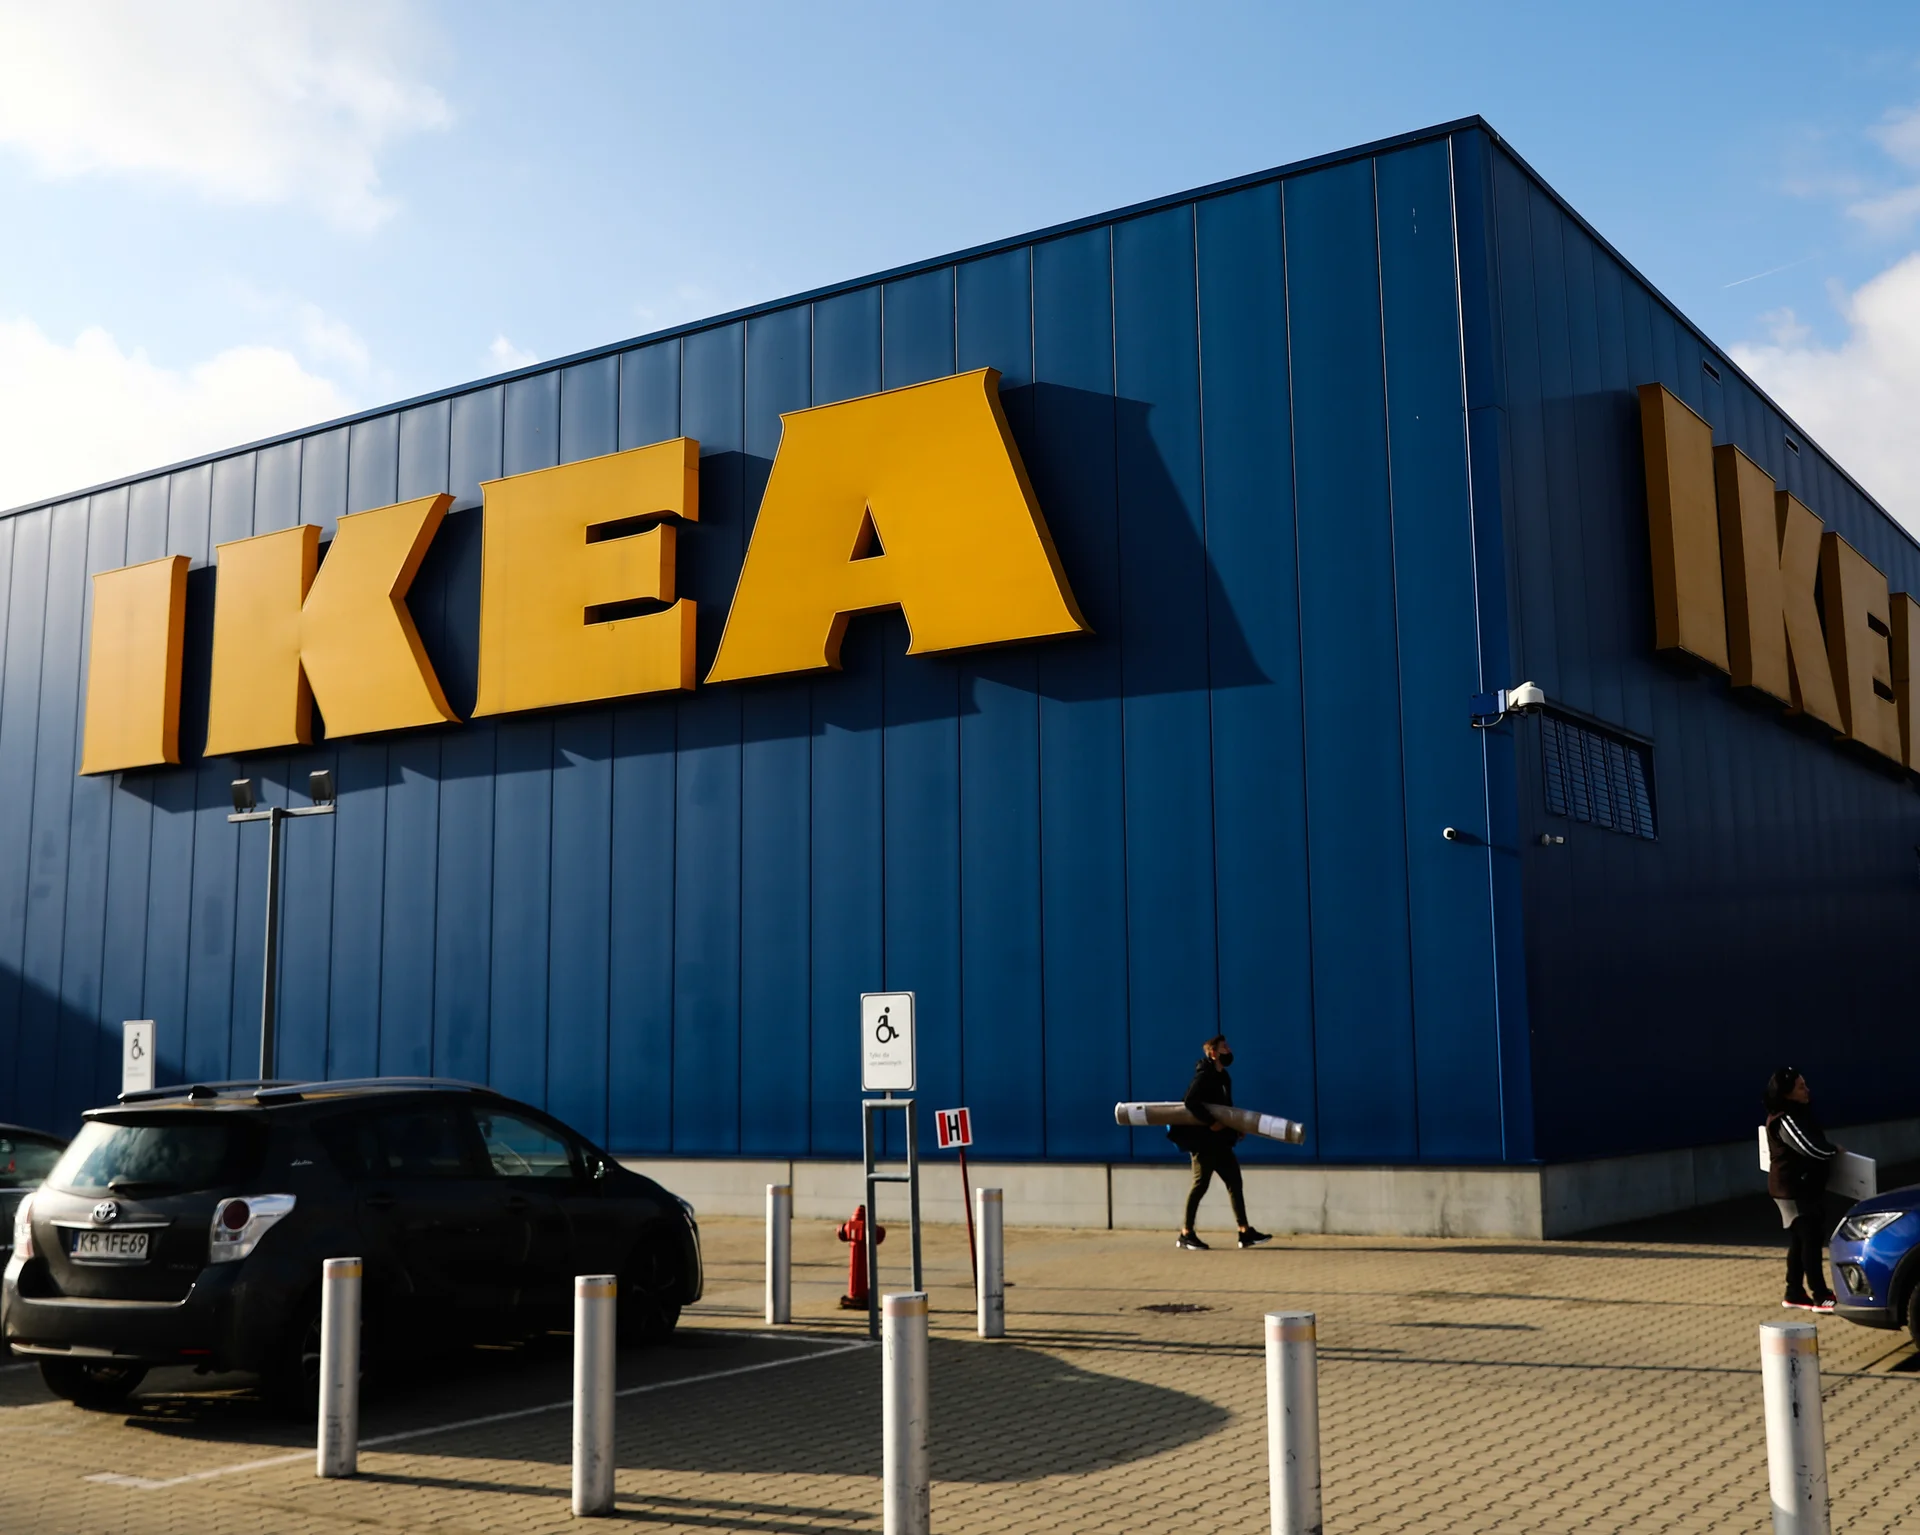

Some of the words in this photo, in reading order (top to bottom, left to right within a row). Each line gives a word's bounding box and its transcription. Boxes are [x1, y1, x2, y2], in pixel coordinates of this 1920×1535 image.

[81, 368, 1092, 776] IKEA
[1637, 382, 1920, 776] IKE
[946, 1114, 961, 1142] H
[80, 1233, 100, 1252] KR
[105, 1233, 147, 1254] 1FE69
